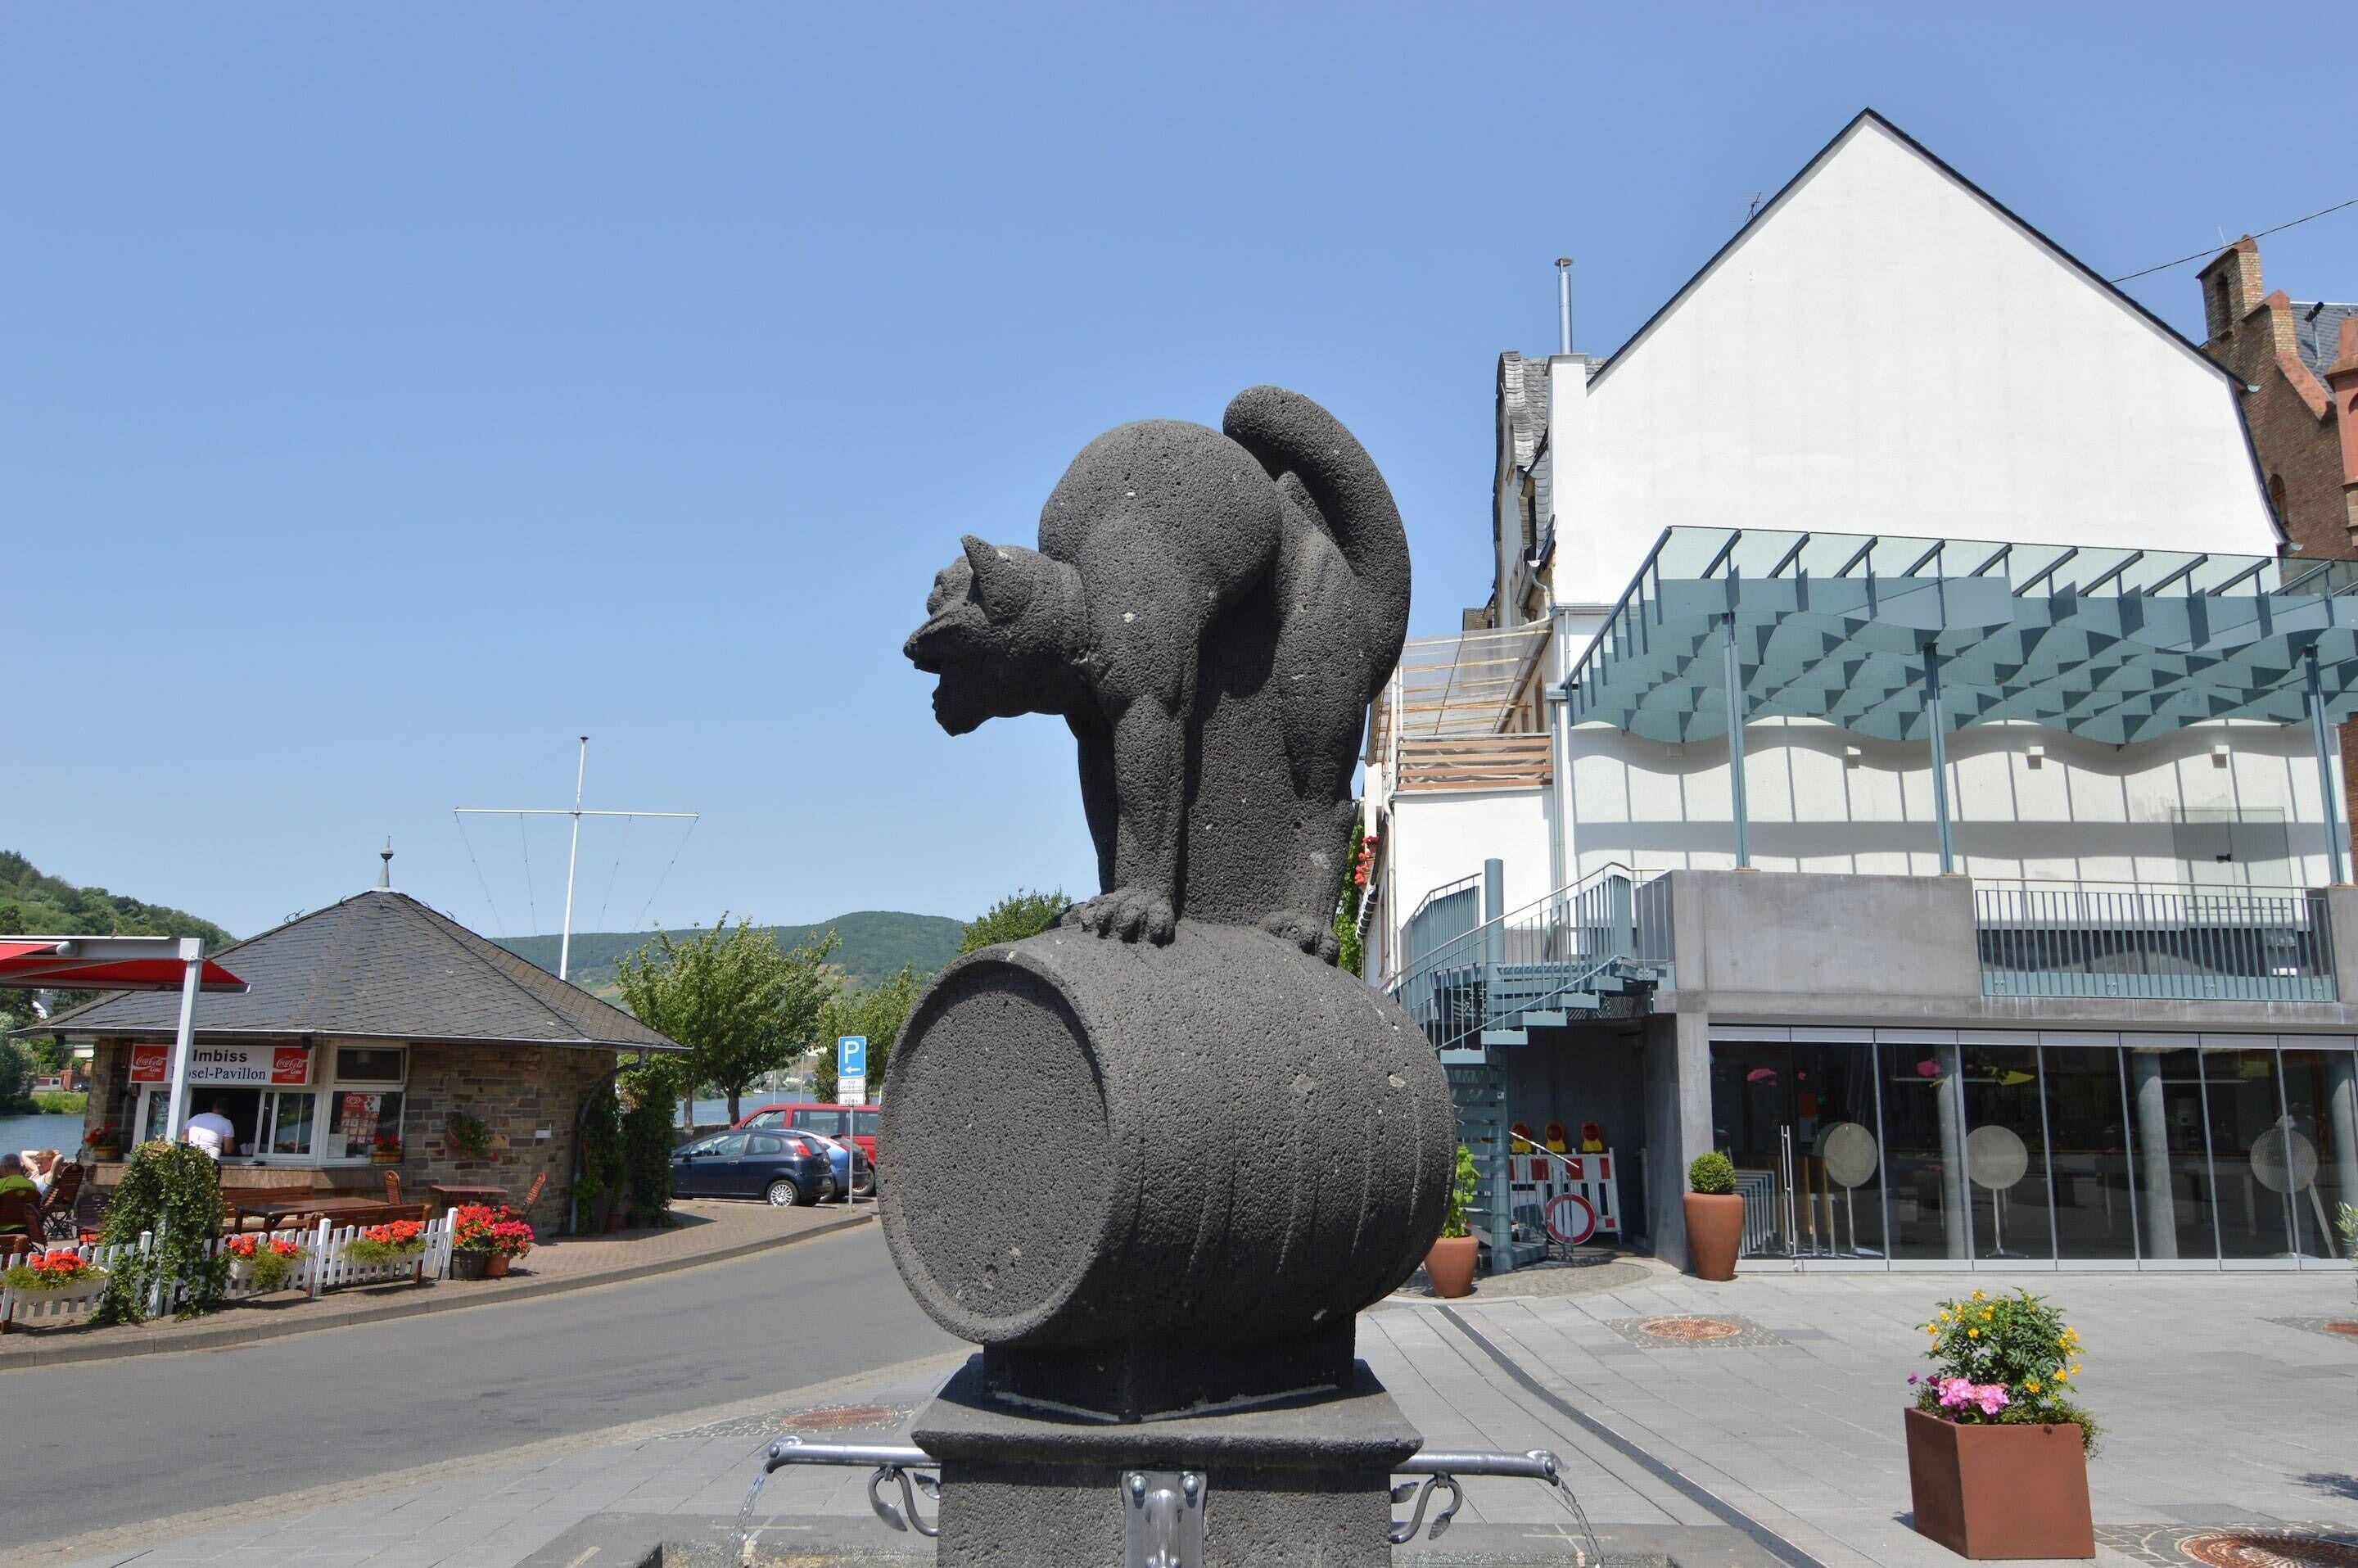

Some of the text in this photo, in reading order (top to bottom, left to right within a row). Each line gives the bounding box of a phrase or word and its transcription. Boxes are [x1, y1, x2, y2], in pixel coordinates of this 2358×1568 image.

[193, 1050, 247, 1063] Imbiss
[844, 1041, 860, 1064] P
[170, 1066, 266, 1080] sel-Pavillon
